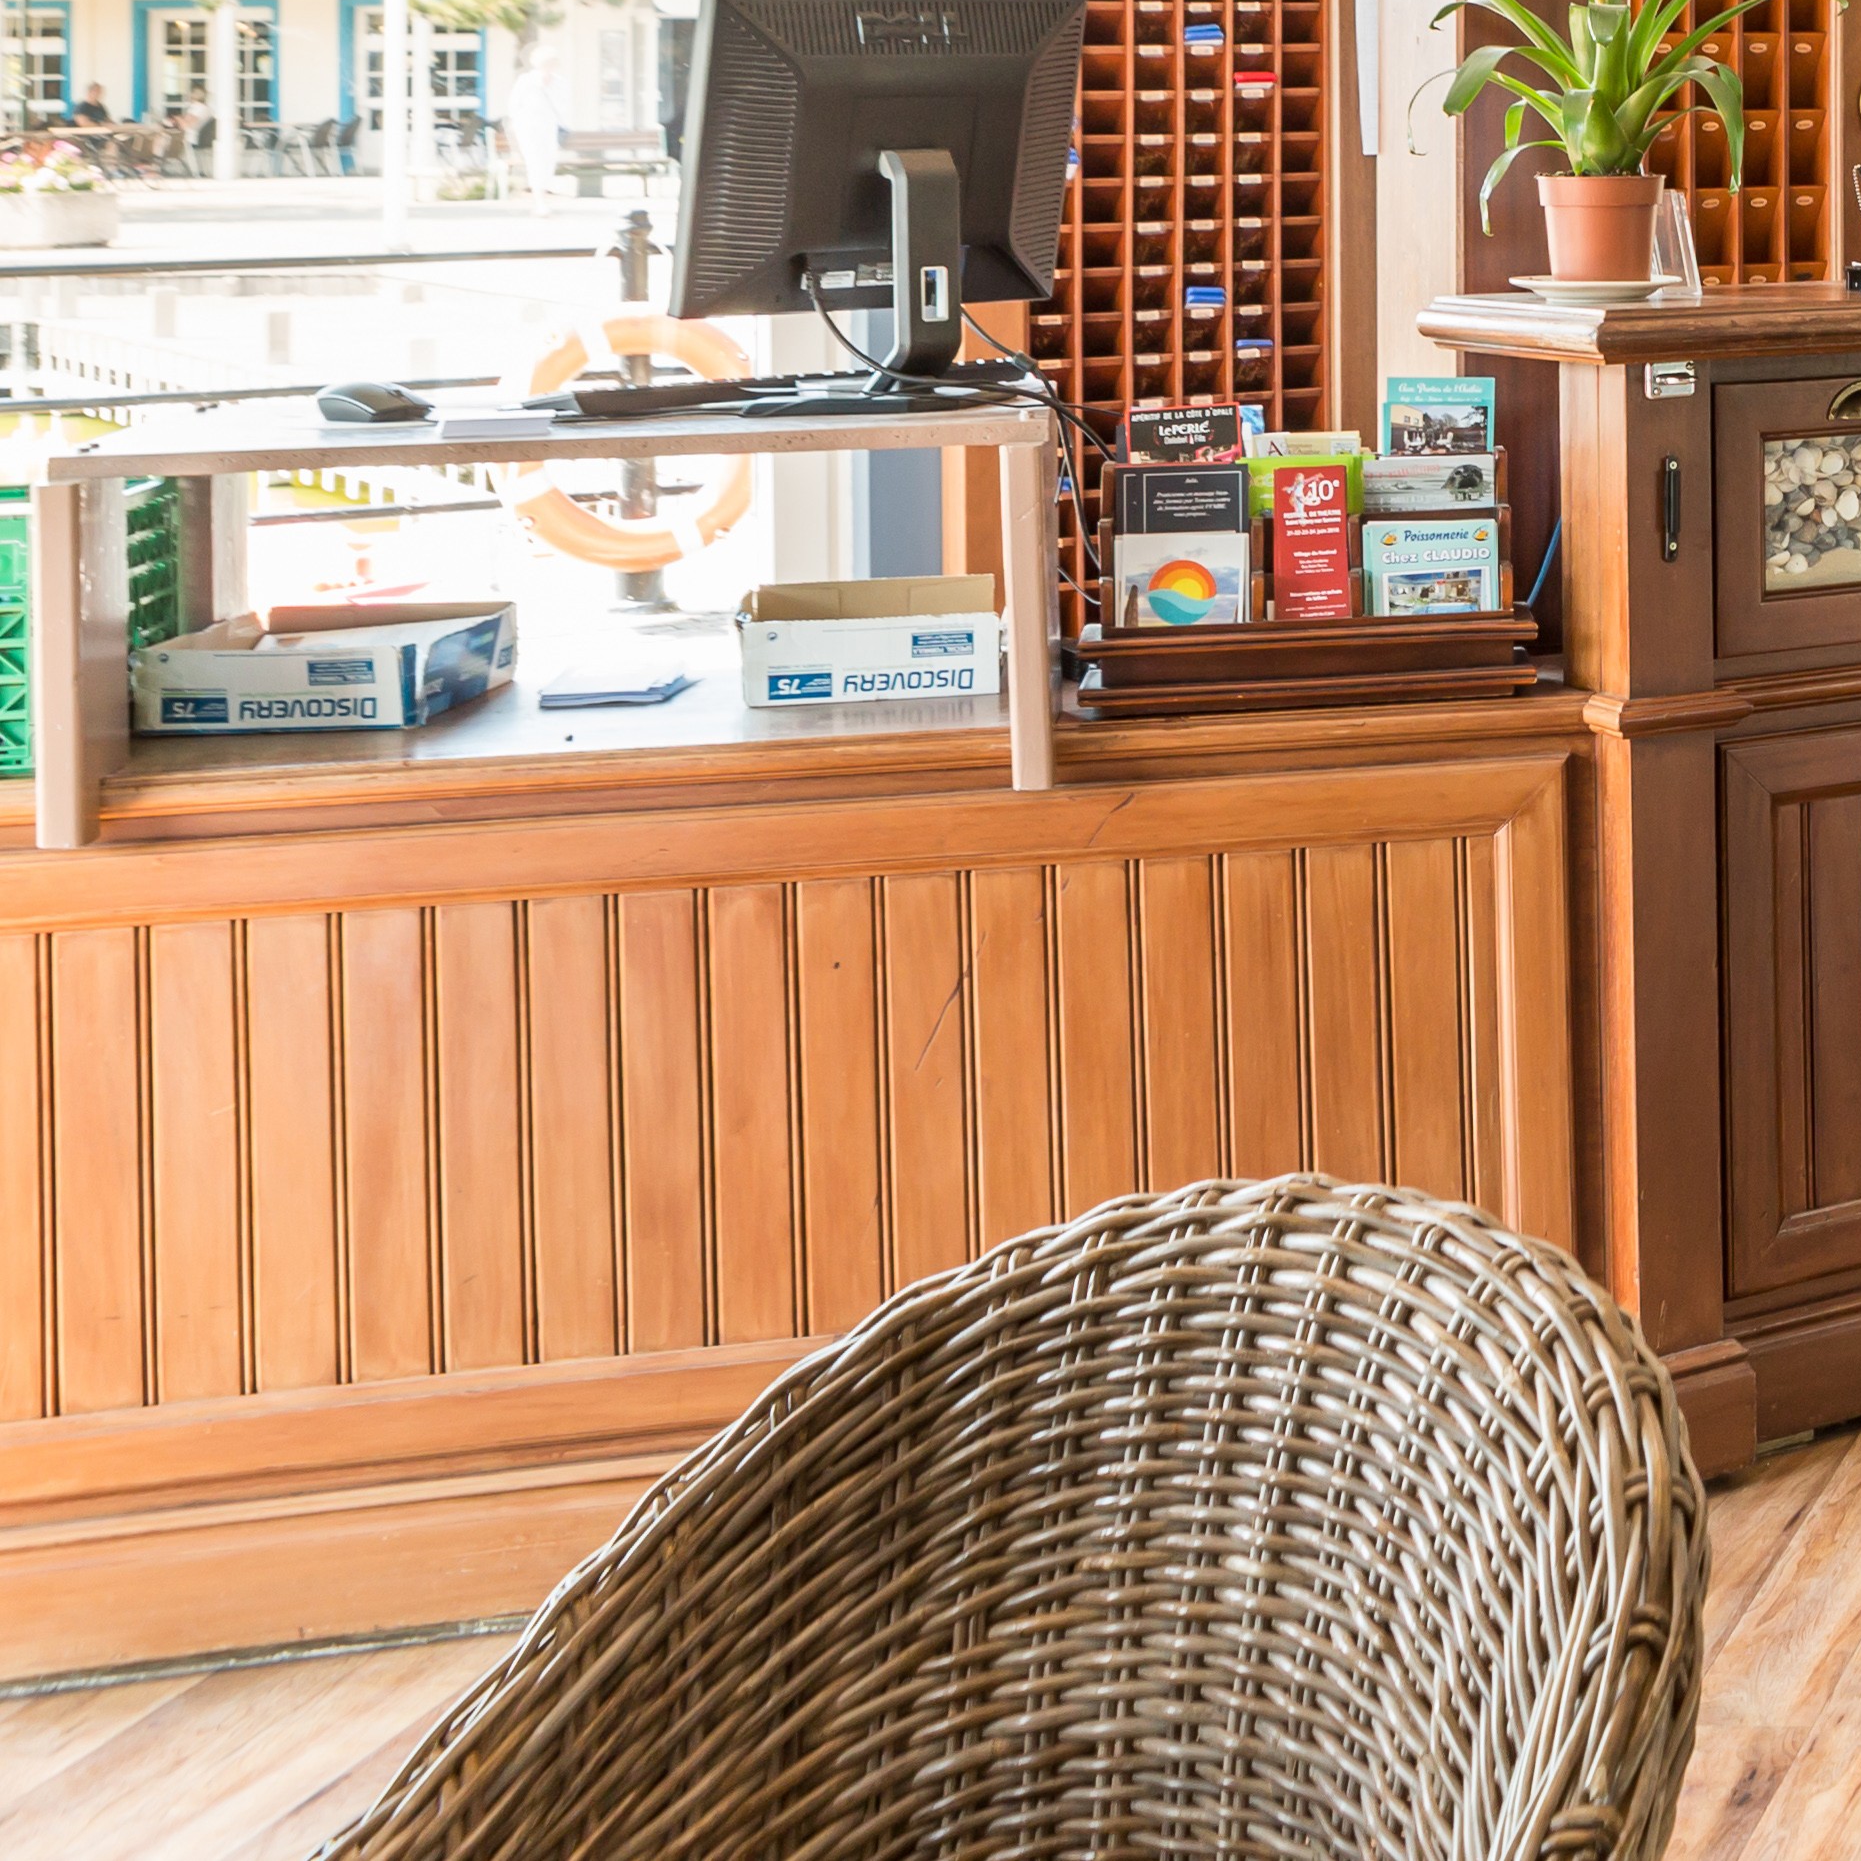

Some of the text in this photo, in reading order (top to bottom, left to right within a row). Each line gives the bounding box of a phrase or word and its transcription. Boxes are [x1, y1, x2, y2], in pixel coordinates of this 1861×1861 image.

[1174, 411, 1184, 419] LA
[1404, 528, 1468, 542] Poissonnerie
[1382, 547, 1491, 564] Chez CLAUDIO
[776, 668, 975, 695] DISCOVERY 75
[172, 697, 378, 721] DISCOVERY 75
